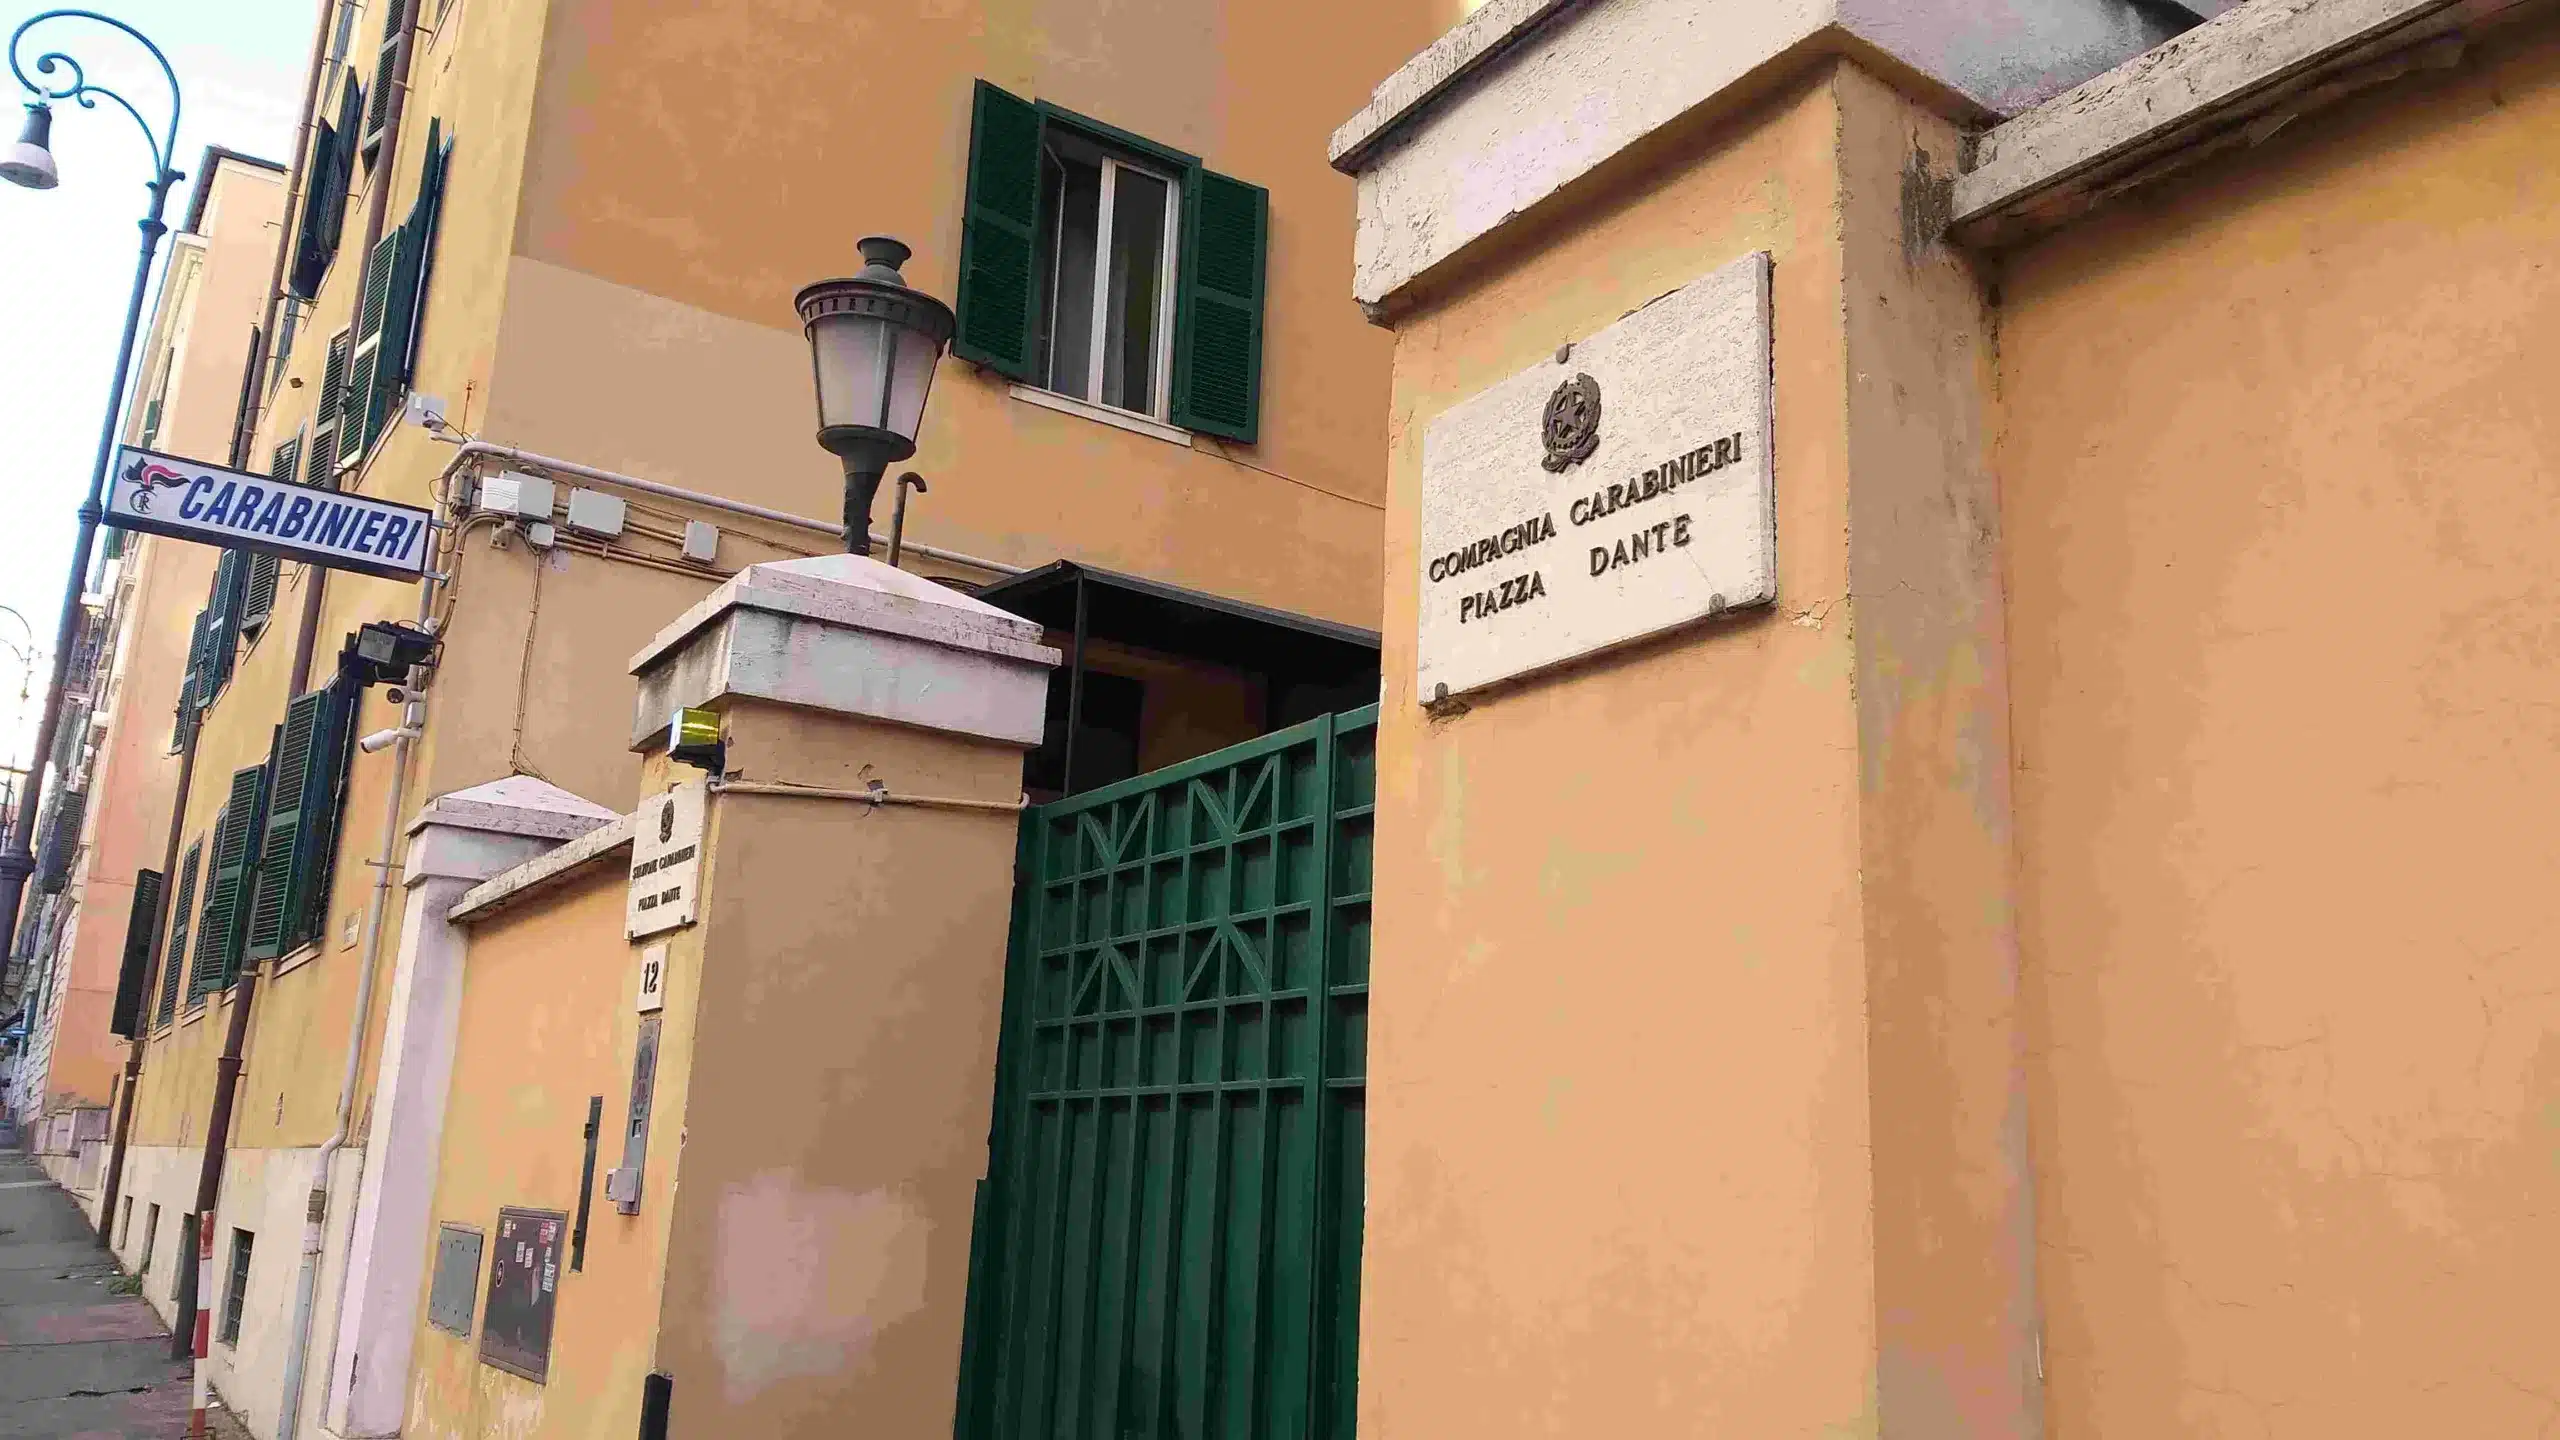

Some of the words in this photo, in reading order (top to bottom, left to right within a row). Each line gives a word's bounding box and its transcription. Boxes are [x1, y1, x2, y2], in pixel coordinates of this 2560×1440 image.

[178, 475, 422, 561] CARABINIERI
[1428, 512, 1557, 582] COMPAGNIA
[1569, 432, 1743, 526] CARABINIERI
[1459, 570, 1546, 624] PIAZZA
[1589, 513, 1693, 577] DANTE
[643, 960, 659, 994] 12
